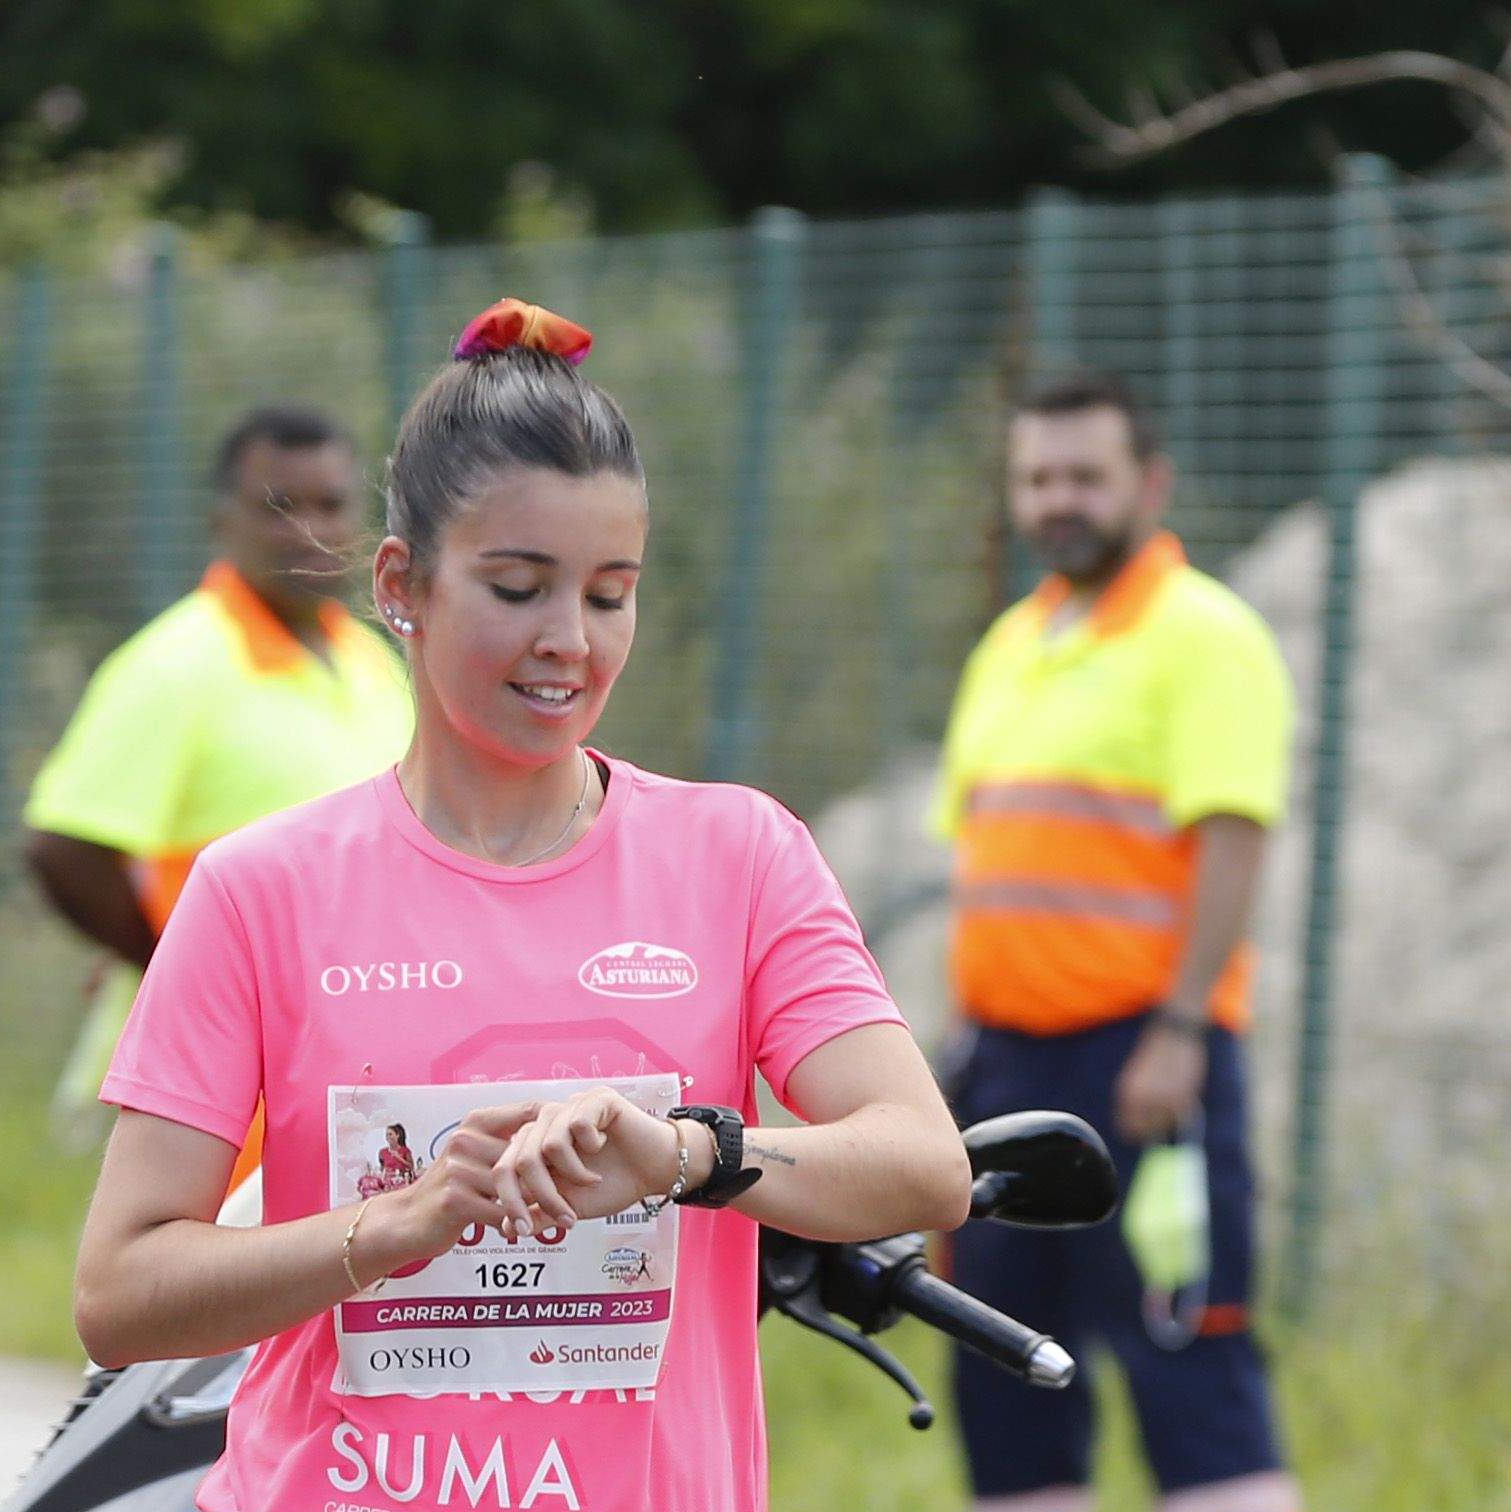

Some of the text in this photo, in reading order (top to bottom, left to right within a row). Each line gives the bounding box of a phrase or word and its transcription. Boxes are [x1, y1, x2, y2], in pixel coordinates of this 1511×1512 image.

[320, 960, 464, 996] OYSHO
[589, 962, 691, 986] ASTURIANA
[475, 1262, 546, 1288] 1627
[376, 1300, 654, 1324] CARRERA DE LA MUJER 2023
[369, 1346, 471, 1372] OYSHO
[558, 1342, 659, 1364] Santander
[326, 1422, 581, 1511] SUMA
